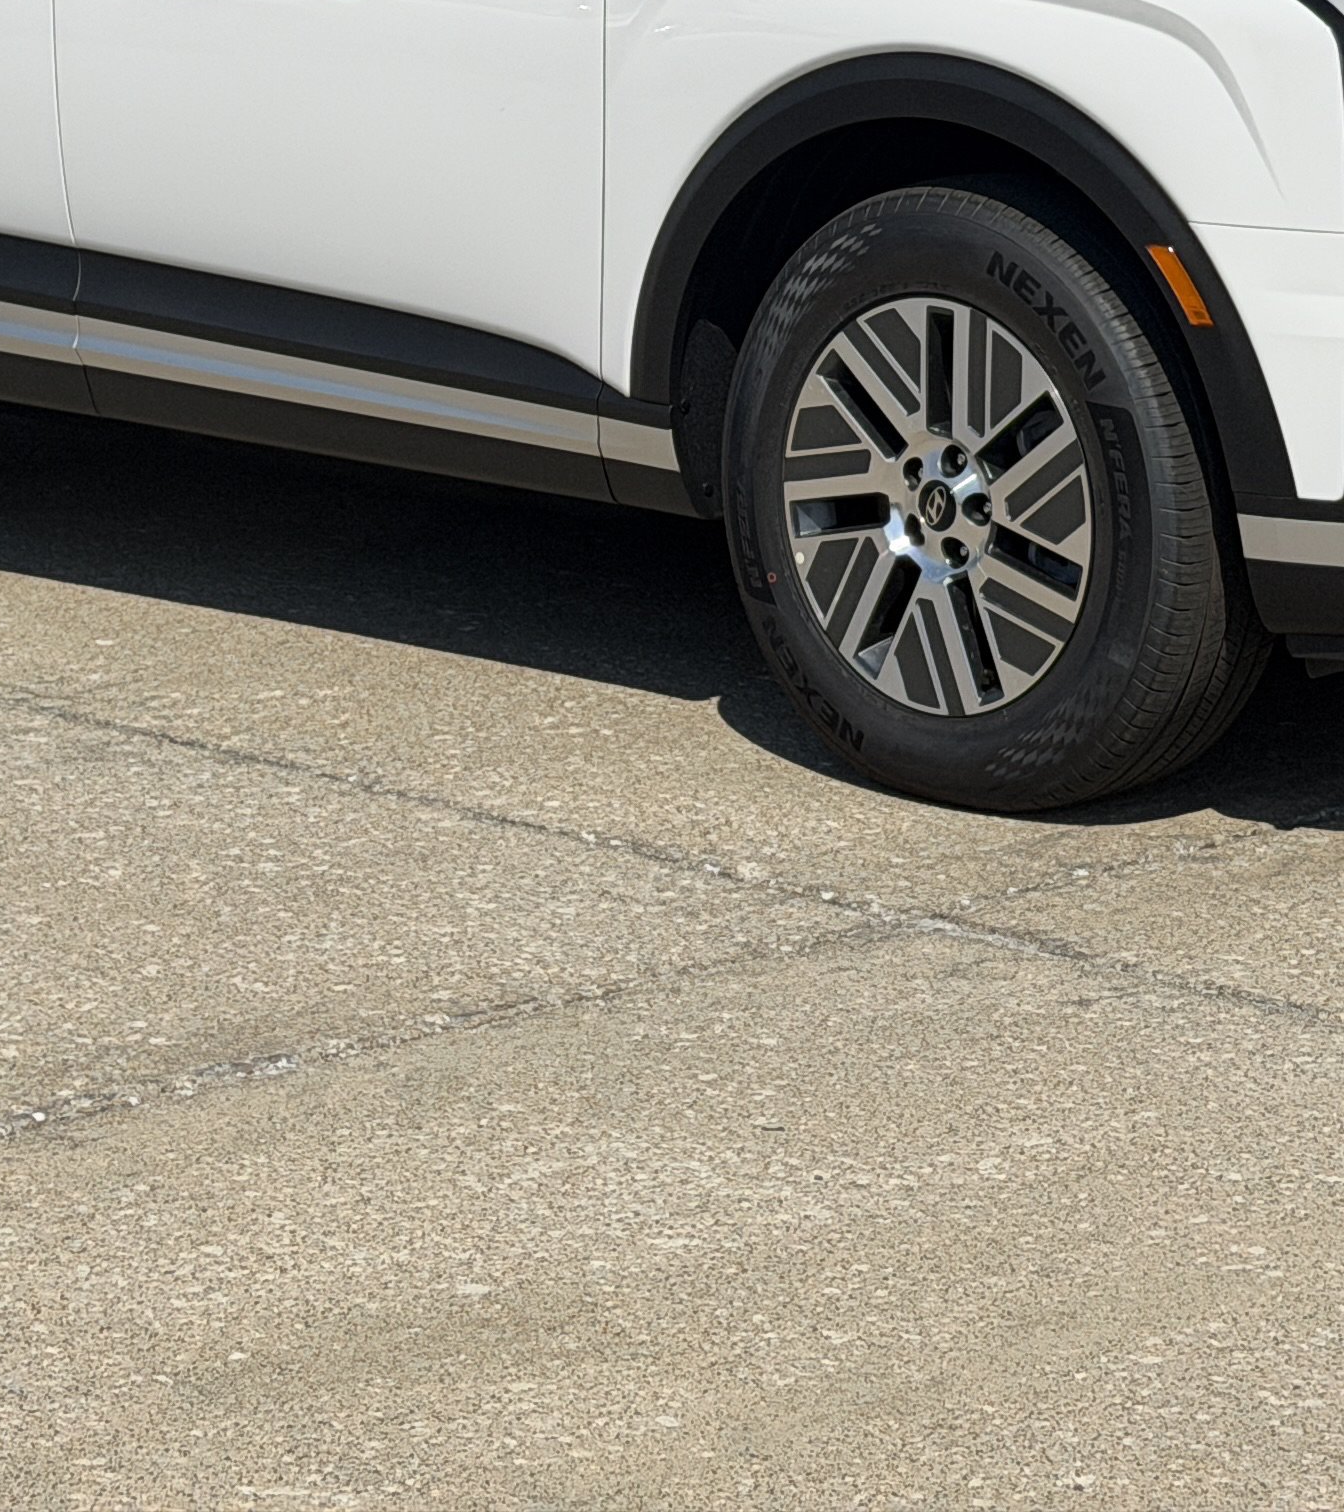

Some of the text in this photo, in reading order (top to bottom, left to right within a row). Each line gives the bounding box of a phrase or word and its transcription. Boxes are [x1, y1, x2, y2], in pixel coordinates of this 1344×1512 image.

[986, 250, 1107, 392] NEXEN
[1098, 417, 1133, 541] N'FERA
[761, 615, 865, 754] NEXEN
